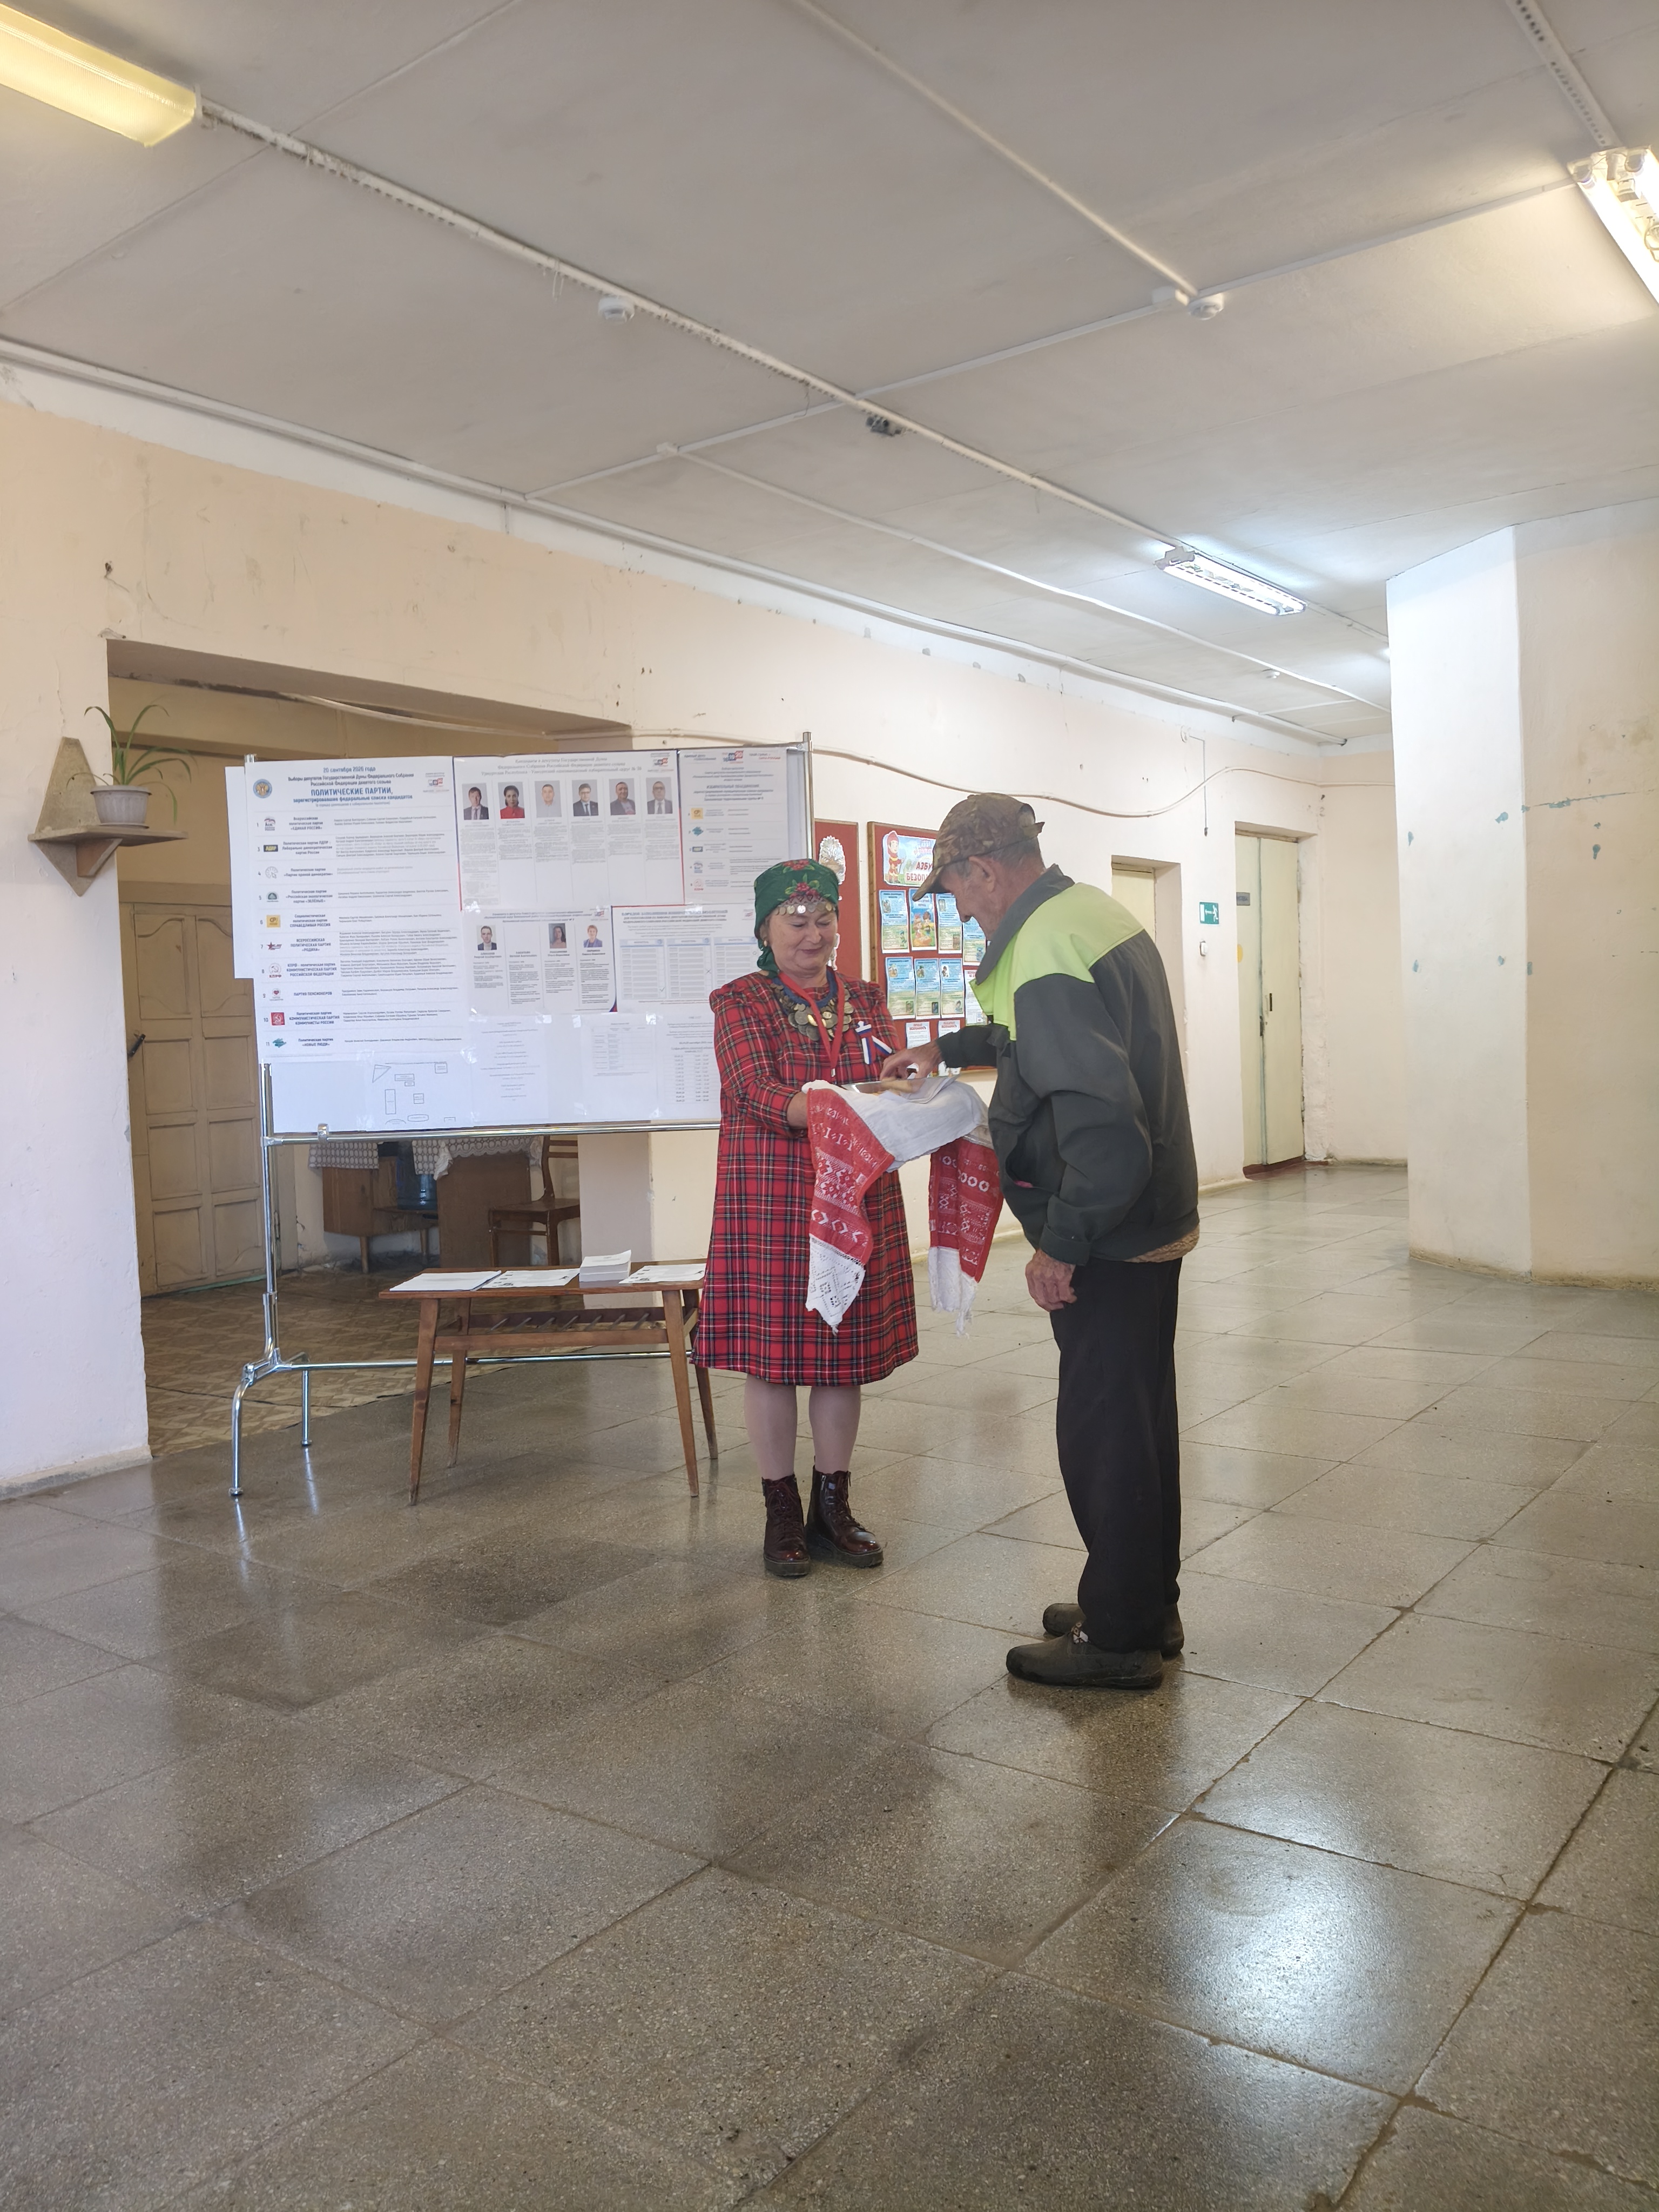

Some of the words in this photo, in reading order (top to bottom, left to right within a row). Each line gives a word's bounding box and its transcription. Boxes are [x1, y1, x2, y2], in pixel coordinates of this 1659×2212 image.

[311, 788, 363, 796] ПОЛИТИЧЕСКИЕ
[365, 787, 393, 795] ПАРТИИ,
[906, 873, 927, 881] БЕЗОП
